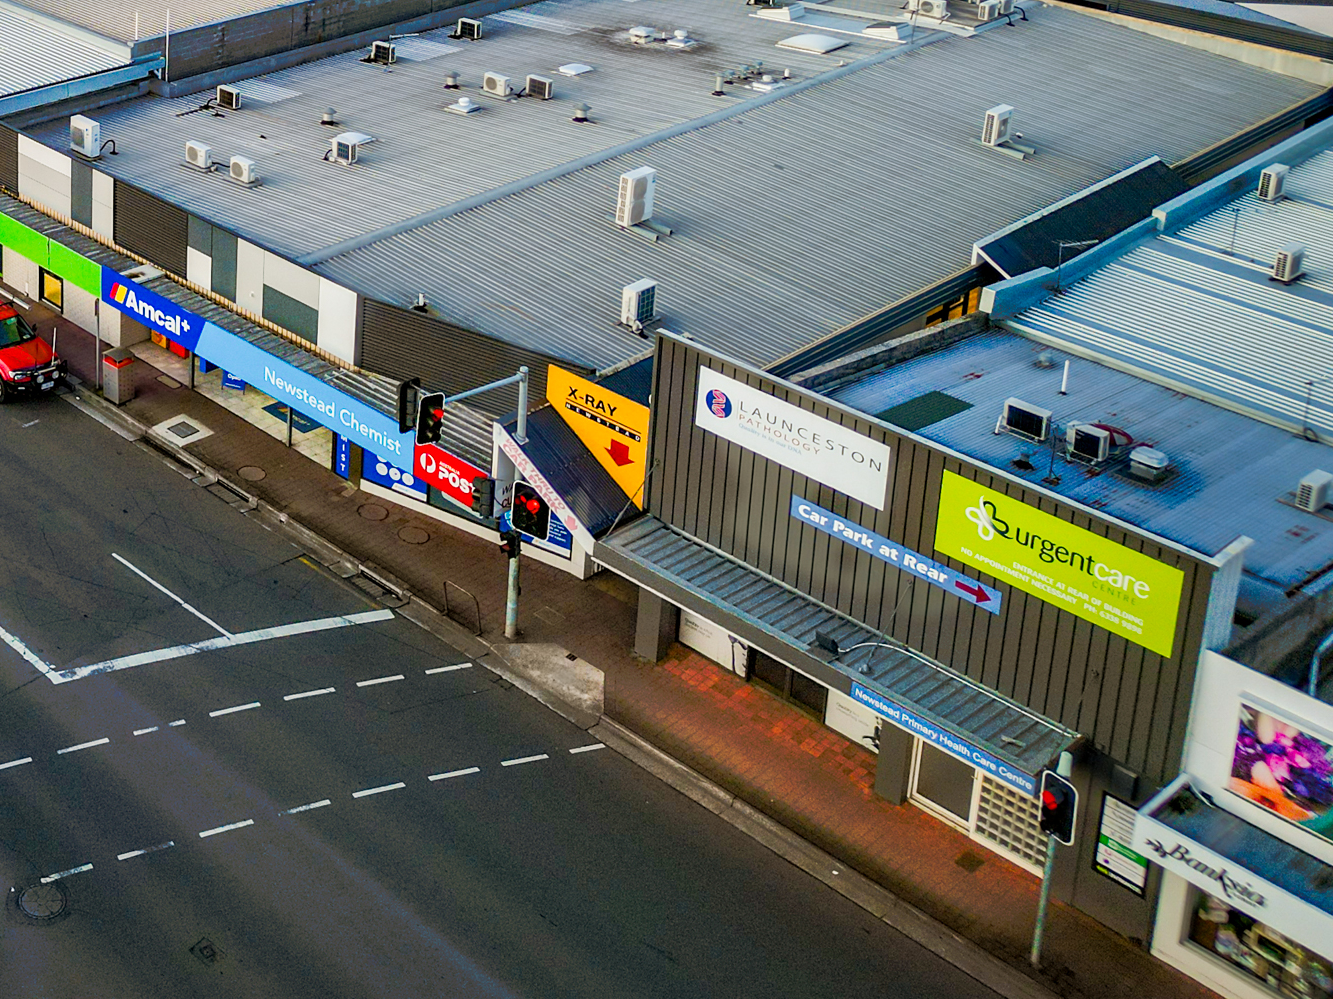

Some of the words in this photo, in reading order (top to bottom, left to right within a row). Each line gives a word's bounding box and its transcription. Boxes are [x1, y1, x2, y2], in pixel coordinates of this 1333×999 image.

[125, 290, 191, 336] Amcal+
[264, 365, 335, 418] Newstead
[339, 408, 402, 456] Chemist
[566, 402, 641, 442] NEWSTEAD
[567, 385, 618, 417] X-RAY
[739, 413, 820, 455] PATHOLOGY
[739, 401, 882, 472] LAUNCESTON
[502, 443, 527, 473] CAR
[528, 474, 561, 513] PARK
[506, 438, 529, 465] WALK
[531, 467, 554, 494] THRU
[554, 495, 566, 510] TO
[798, 504, 828, 526] Car
[833, 519, 874, 549] Park
[878, 543, 898, 561] at
[903, 553, 948, 583] Rear
[960, 546, 973, 557] NO
[974, 553, 1030, 584] APPOINTMENT
[1031, 578, 1077, 604] NECESSARY
[1013, 562, 1054, 585] ENTRANCE
[1055, 582, 1066, 590] AT
[1067, 586, 1089, 601] REAR
[1091, 597, 1102, 606] OF
[1103, 603, 1144, 626] BUILDING
[1092, 581, 1136, 605] CENTRE
[855, 688, 900, 719] Newstead
[901, 713, 938, 740] Primary
[939, 733, 971, 758] Health
[972, 751, 996, 771] Care
[998, 766, 1033, 790] Centre
[1167, 843, 1265, 907] Banksia
